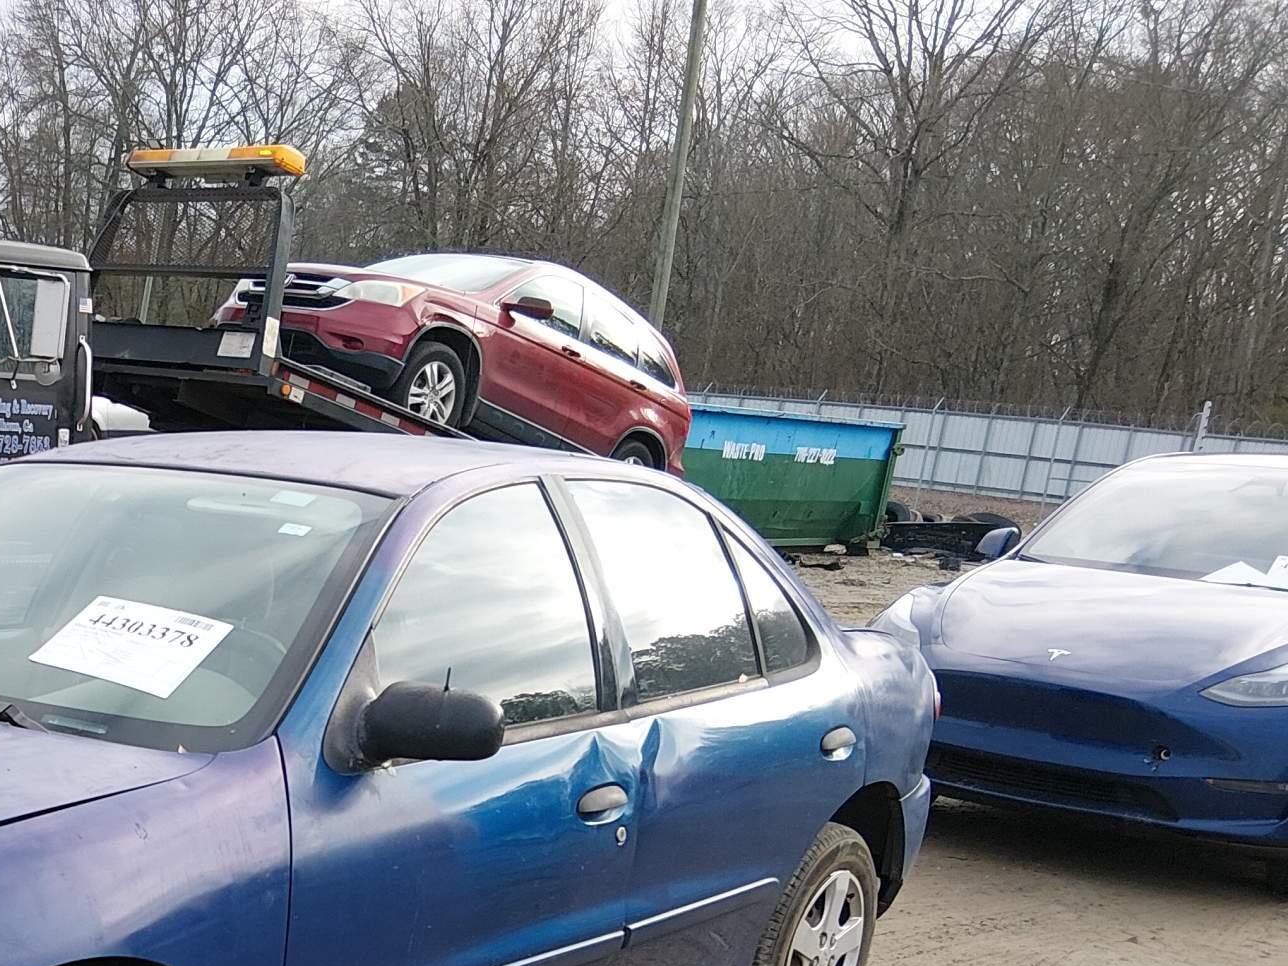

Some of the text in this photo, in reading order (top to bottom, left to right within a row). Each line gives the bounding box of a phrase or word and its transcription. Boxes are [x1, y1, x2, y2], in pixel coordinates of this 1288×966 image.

[12, 398, 20, 415] &
[20, 399, 53, 420] Recovery
[88, 612, 200, 649] 44303378
